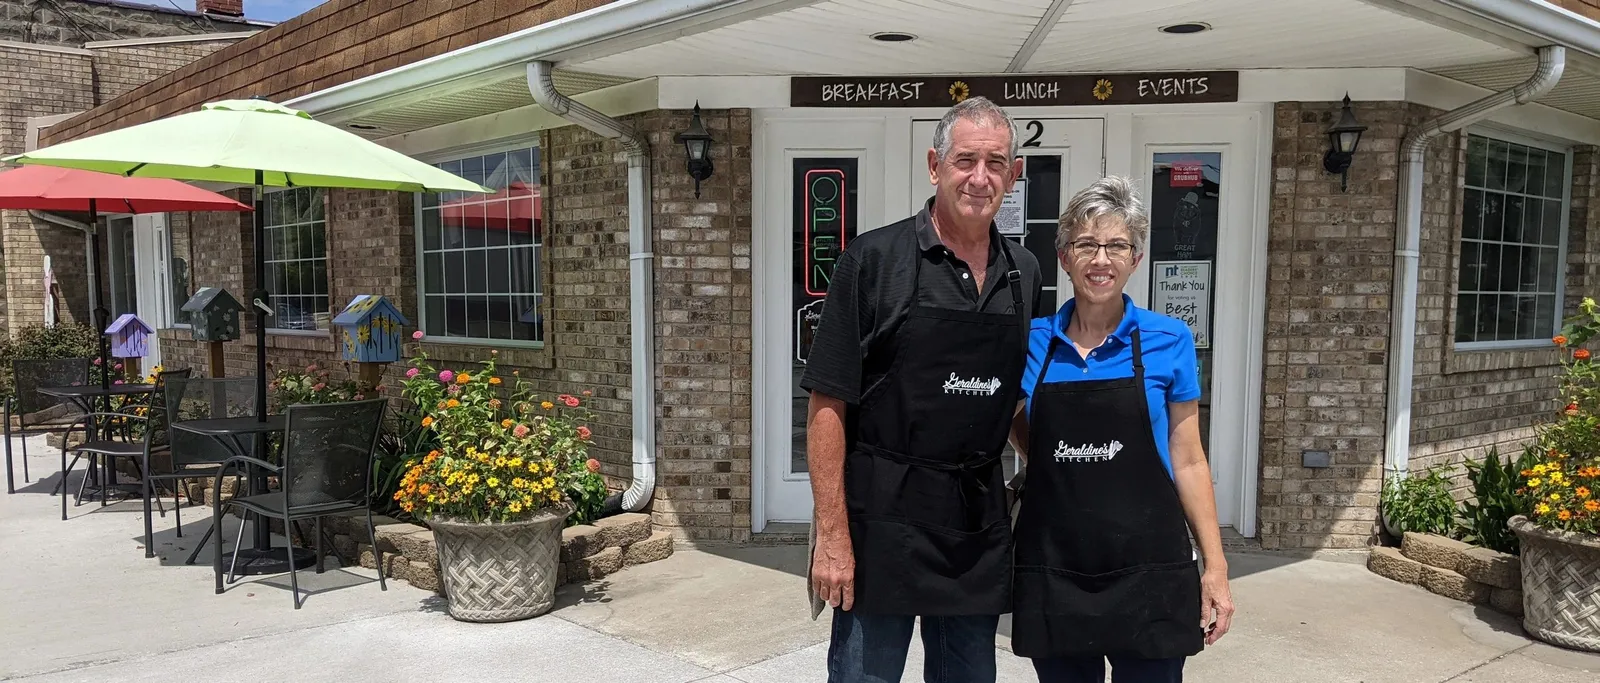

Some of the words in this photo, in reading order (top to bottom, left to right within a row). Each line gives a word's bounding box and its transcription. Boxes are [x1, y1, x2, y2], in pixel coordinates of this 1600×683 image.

[822, 82, 924, 101] BREAKFAST
[1004, 82, 1060, 100] LUNCH
[1138, 77, 1208, 96] EVENTS
[1022, 120, 1044, 147] 2
[811, 176, 838, 289] OPEN
[1165, 264, 1179, 277] nt
[1159, 281, 1188, 291] Thank
[1189, 280, 1205, 291] You
[1165, 302, 1197, 314] Best
[1166, 314, 1197, 327] fe!
[943, 371, 991, 390] Geraldine's
[1054, 440, 1109, 457] Geraldine's
